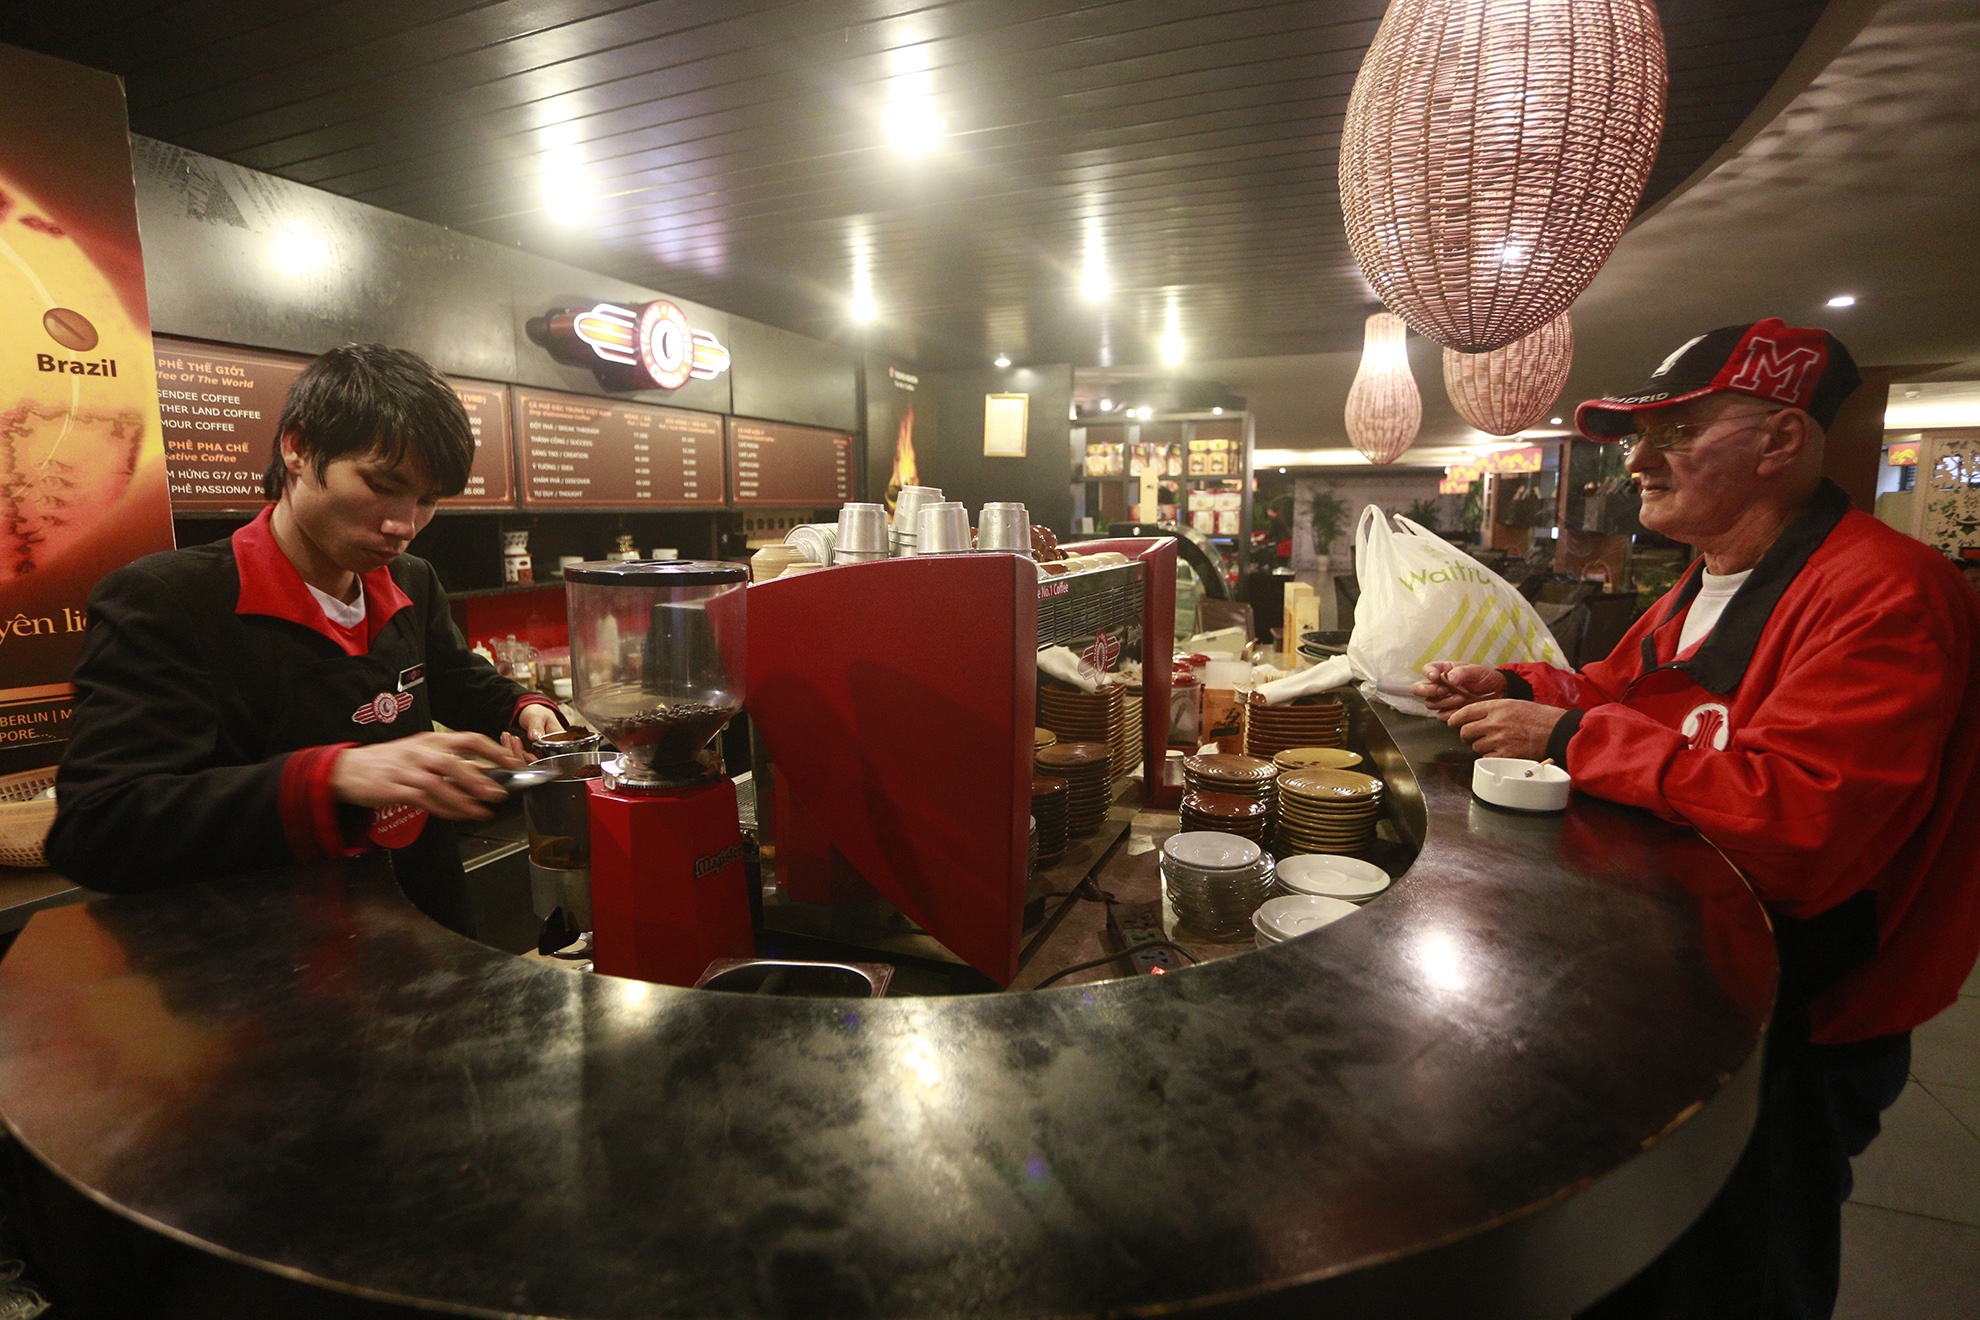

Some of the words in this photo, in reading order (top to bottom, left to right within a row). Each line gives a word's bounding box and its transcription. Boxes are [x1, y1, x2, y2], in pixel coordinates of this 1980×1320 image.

[36, 353, 117, 378] Brazil
[158, 358, 184, 370] PHÊ
[1729, 336, 1821, 404] M
[180, 373, 195, 383] Of
[197, 375, 219, 386] The
[221, 377, 255, 389] World
[201, 393, 241, 405] COFFEE
[192, 405, 221, 417] LAND
[223, 408, 261, 420] COFFEE
[195, 421, 236, 433] COFFEE
[168, 439, 194, 451] PHÊ
[197, 442, 223, 453] PHA
[201, 453, 237, 464] Coffee
[234, 471, 249, 481] G7
[171, 482, 193, 494] PHÊ
[1053, 581, 1069, 596] Coffee
[0, 711, 49, 728] BERLIN
